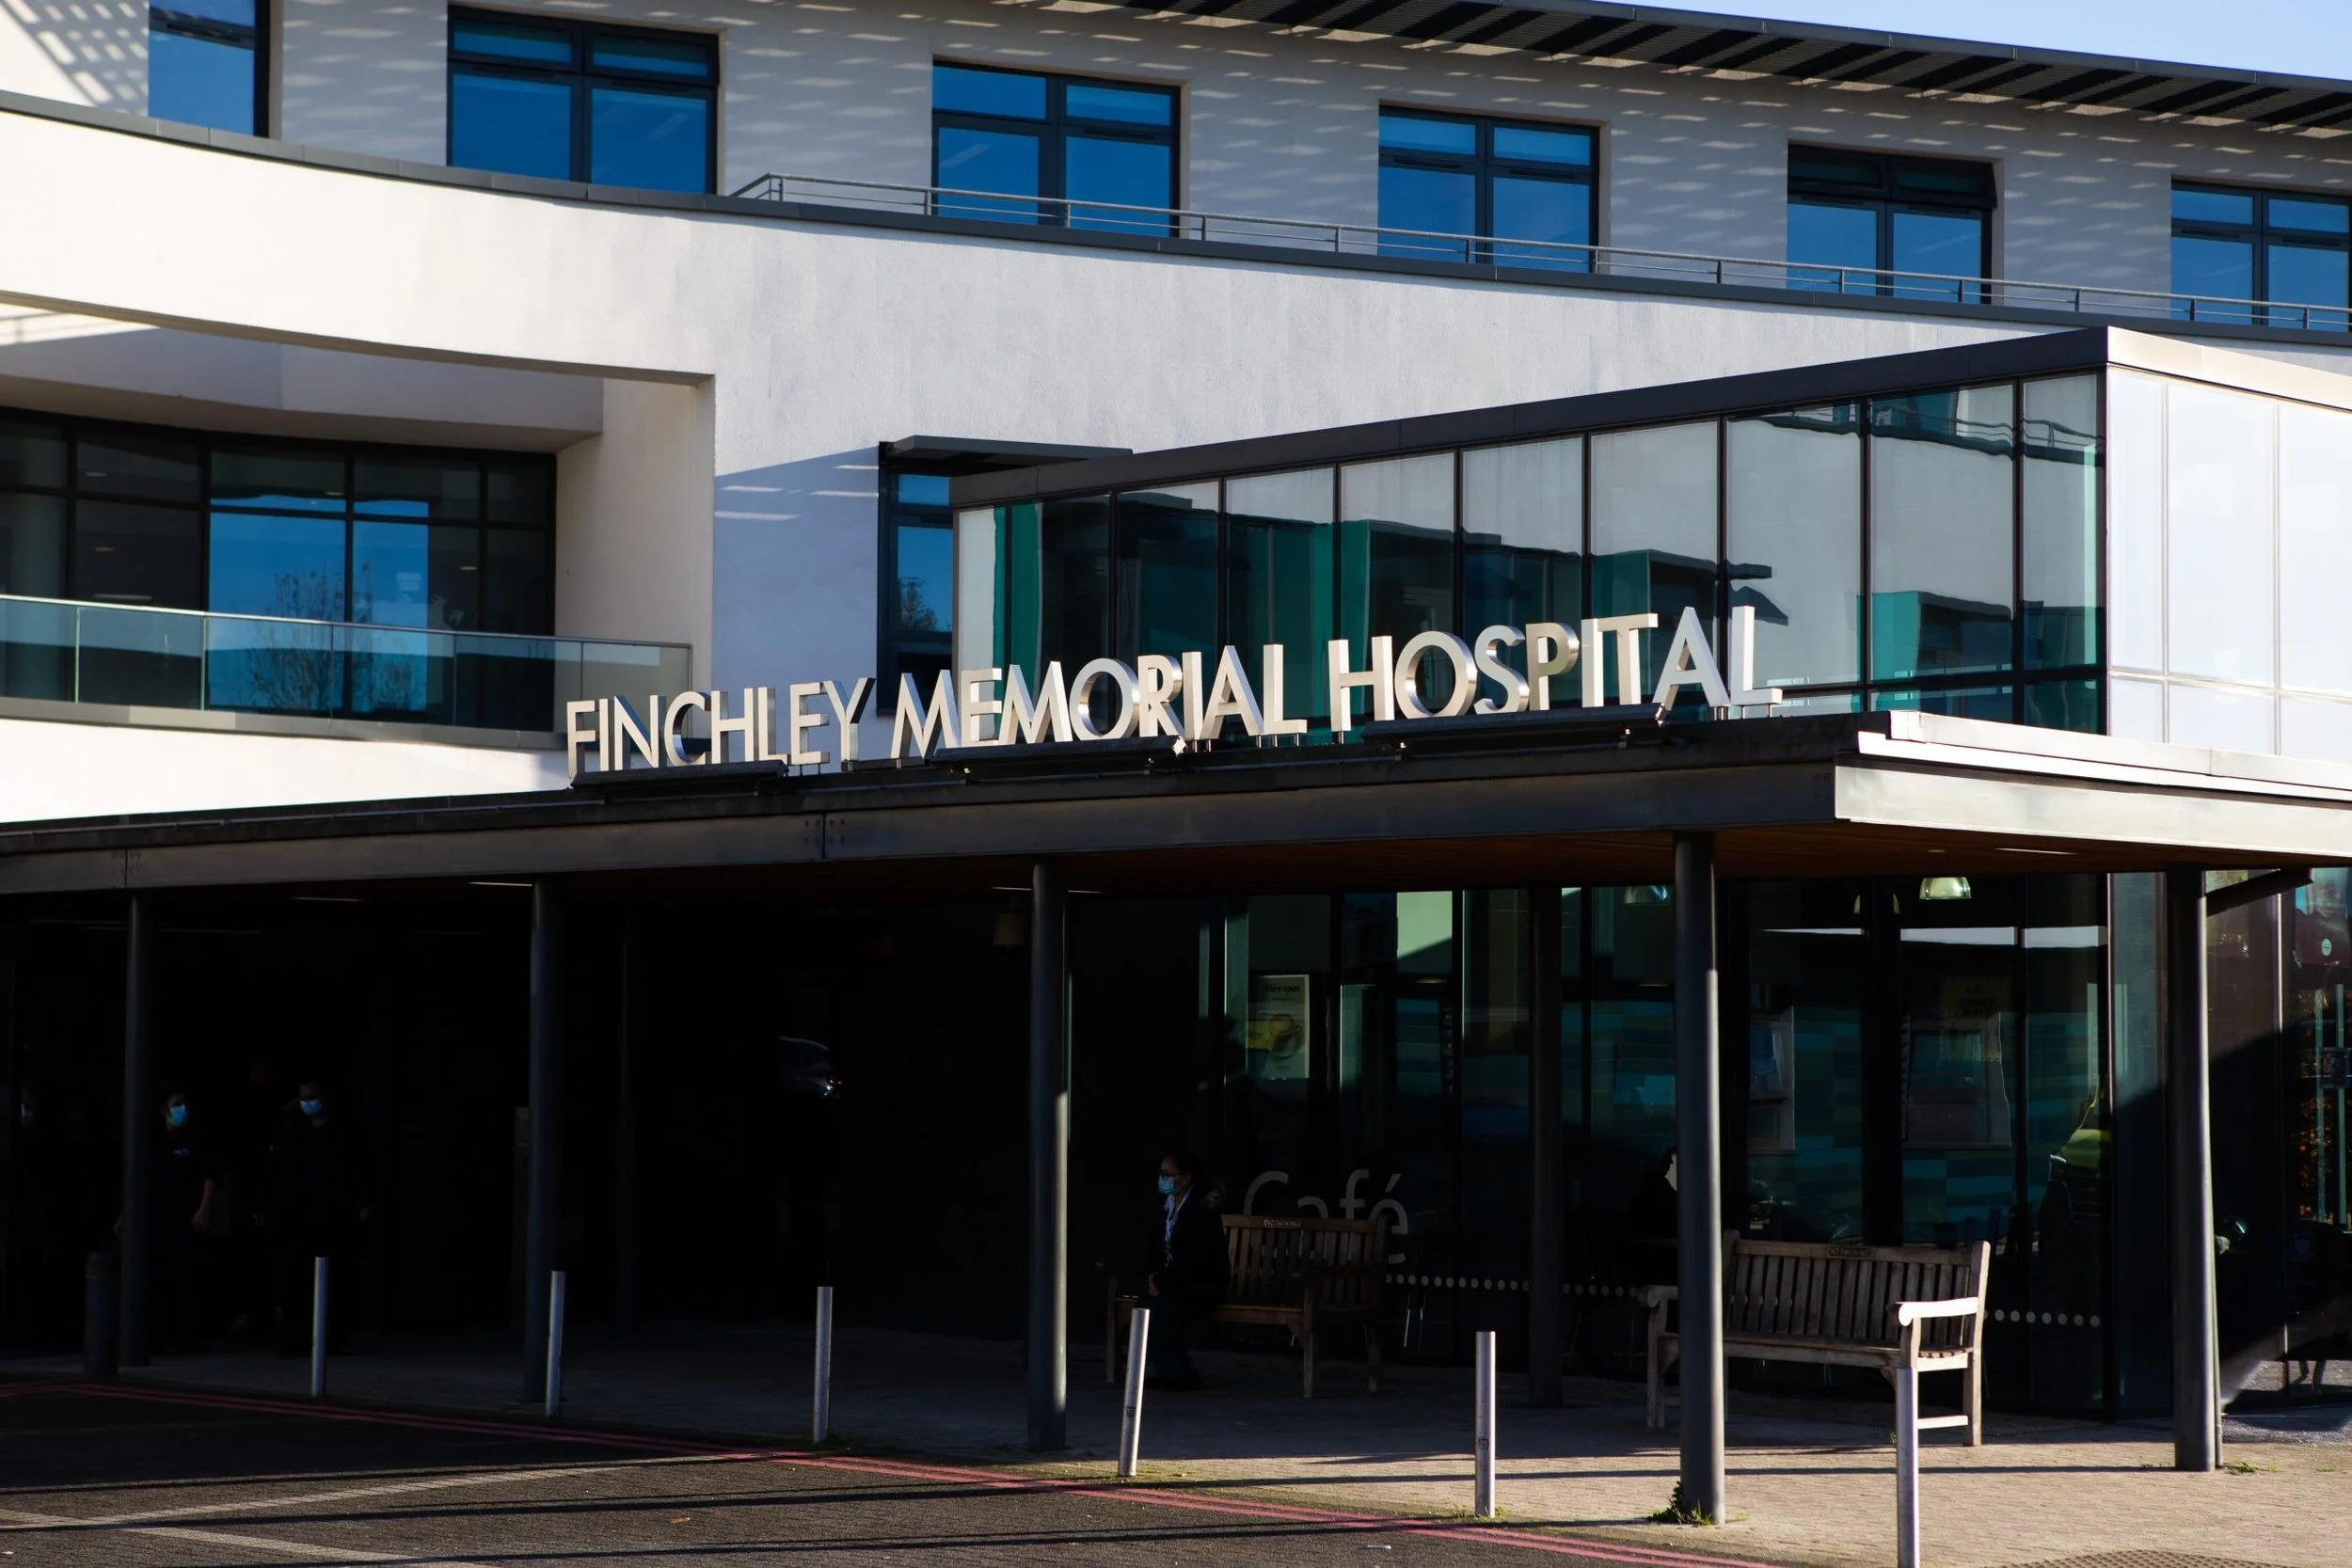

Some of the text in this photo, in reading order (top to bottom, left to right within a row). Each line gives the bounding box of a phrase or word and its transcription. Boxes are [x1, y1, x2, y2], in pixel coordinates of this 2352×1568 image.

[567, 606, 1783, 779] FINCHLEY MEMORIAL HOSPITAL
